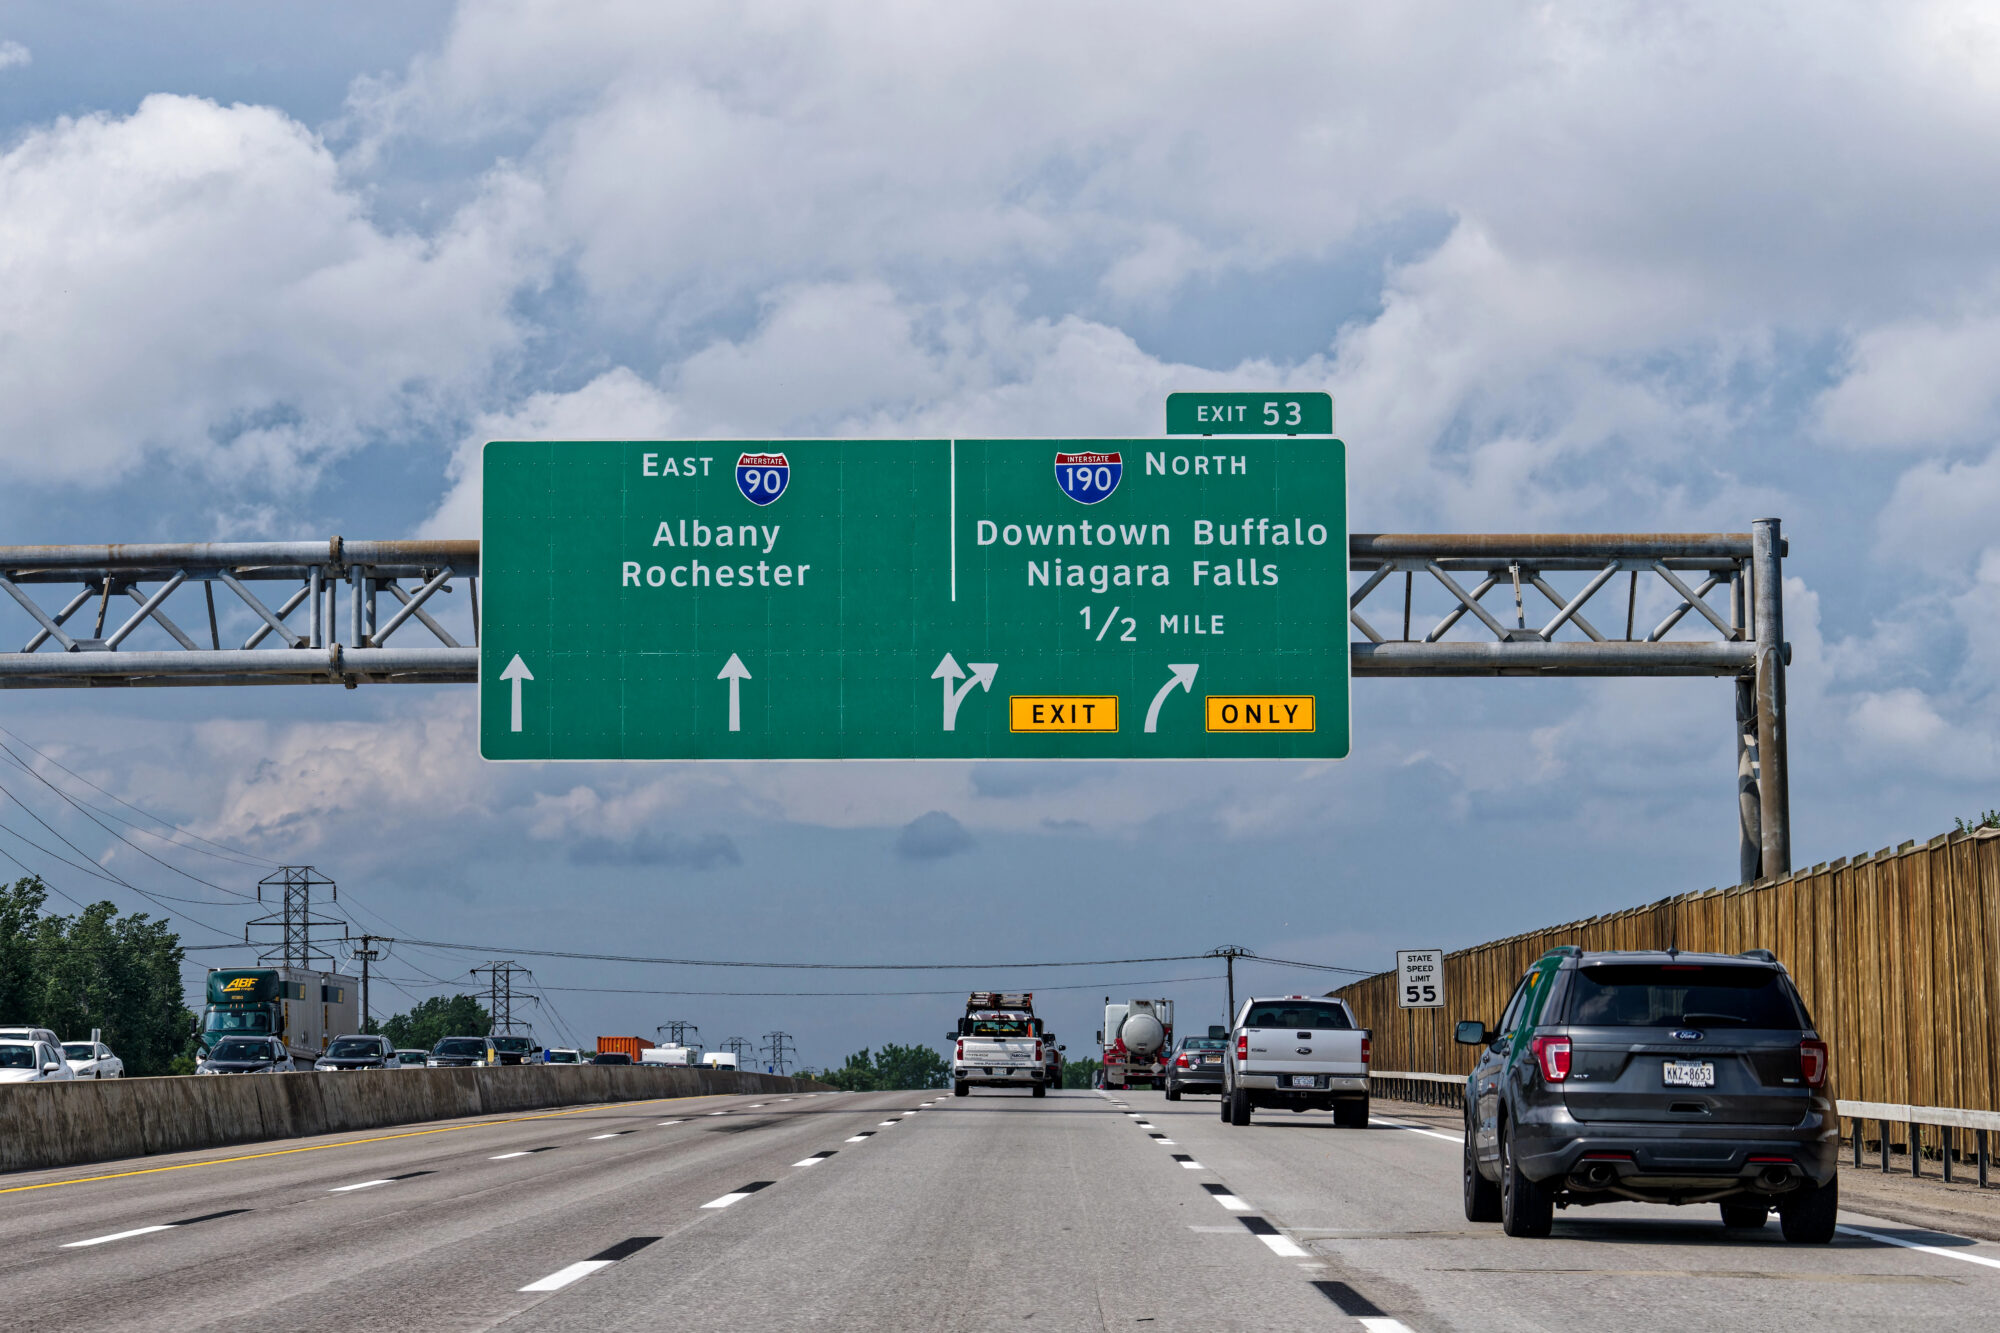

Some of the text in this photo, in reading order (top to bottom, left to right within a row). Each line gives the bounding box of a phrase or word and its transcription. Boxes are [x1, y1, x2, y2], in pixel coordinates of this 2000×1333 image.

[1197, 401, 1302, 426] EXIT 53
[643, 453, 714, 477] EAST
[742, 457, 783, 465] INTERSTATE
[1067, 455, 1109, 463] INTERSTATE
[1145, 451, 1247, 476] NORTH
[744, 469, 781, 494] 90
[1066, 466, 1112, 491] 190
[652, 519, 781, 554] Albany
[977, 518, 1328, 546] Downtown Buffalo
[622, 559, 811, 587] Rochester
[1028, 558, 1279, 594] Niagara Falls
[1160, 614, 1225, 635] MILE
[1032, 704, 1096, 724] EXIT
[1221, 703, 1299, 724] ONLY
[1407, 954, 1433, 962] STATE
[225, 977, 260, 989] ABF
[1406, 985, 1436, 1002] 55
